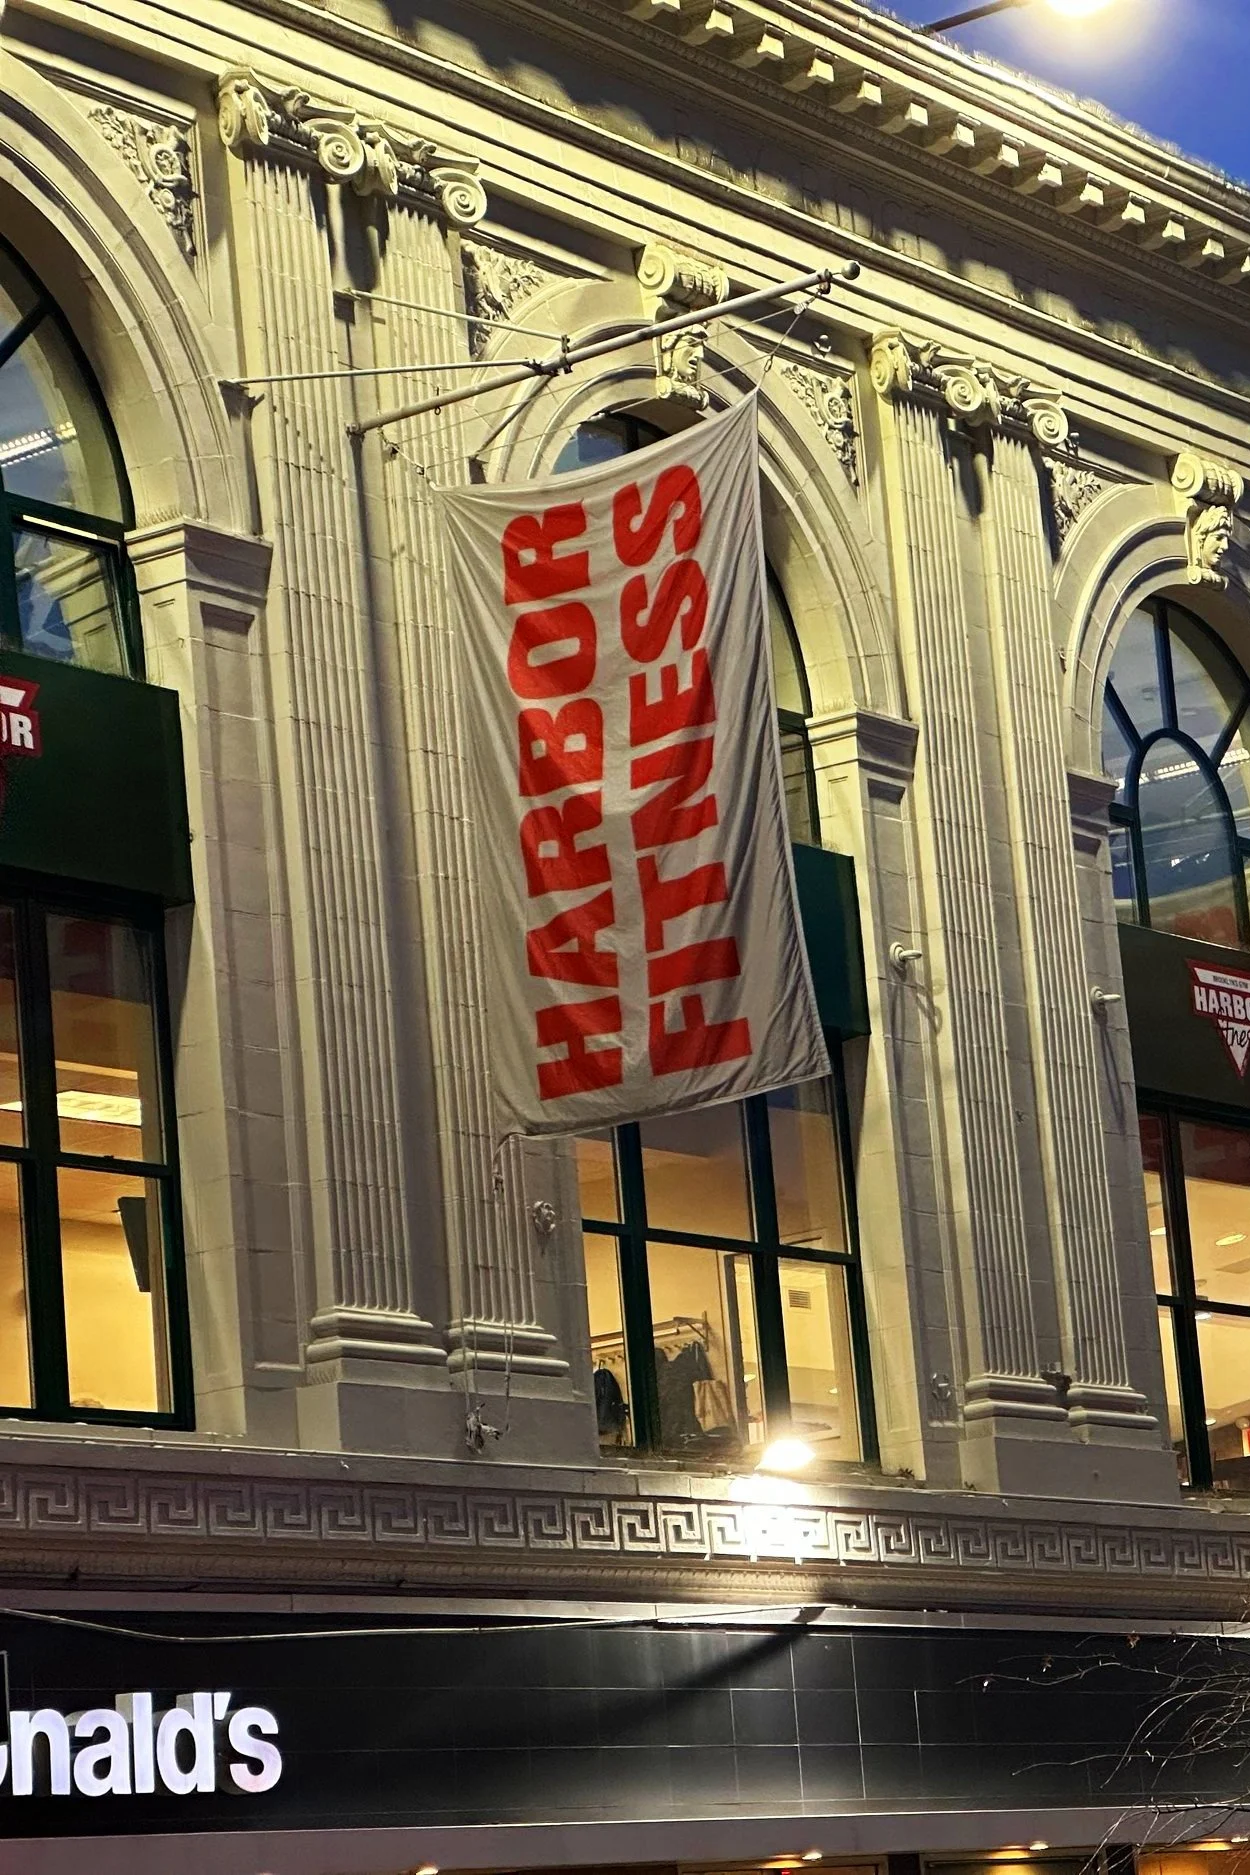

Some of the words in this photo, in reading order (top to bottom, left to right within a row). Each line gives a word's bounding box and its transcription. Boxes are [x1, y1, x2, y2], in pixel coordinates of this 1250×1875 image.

[501, 500, 624, 1100] HARBOR
[612, 463, 753, 1078] FITNESS
[0, 1691, 283, 1797] nald's
